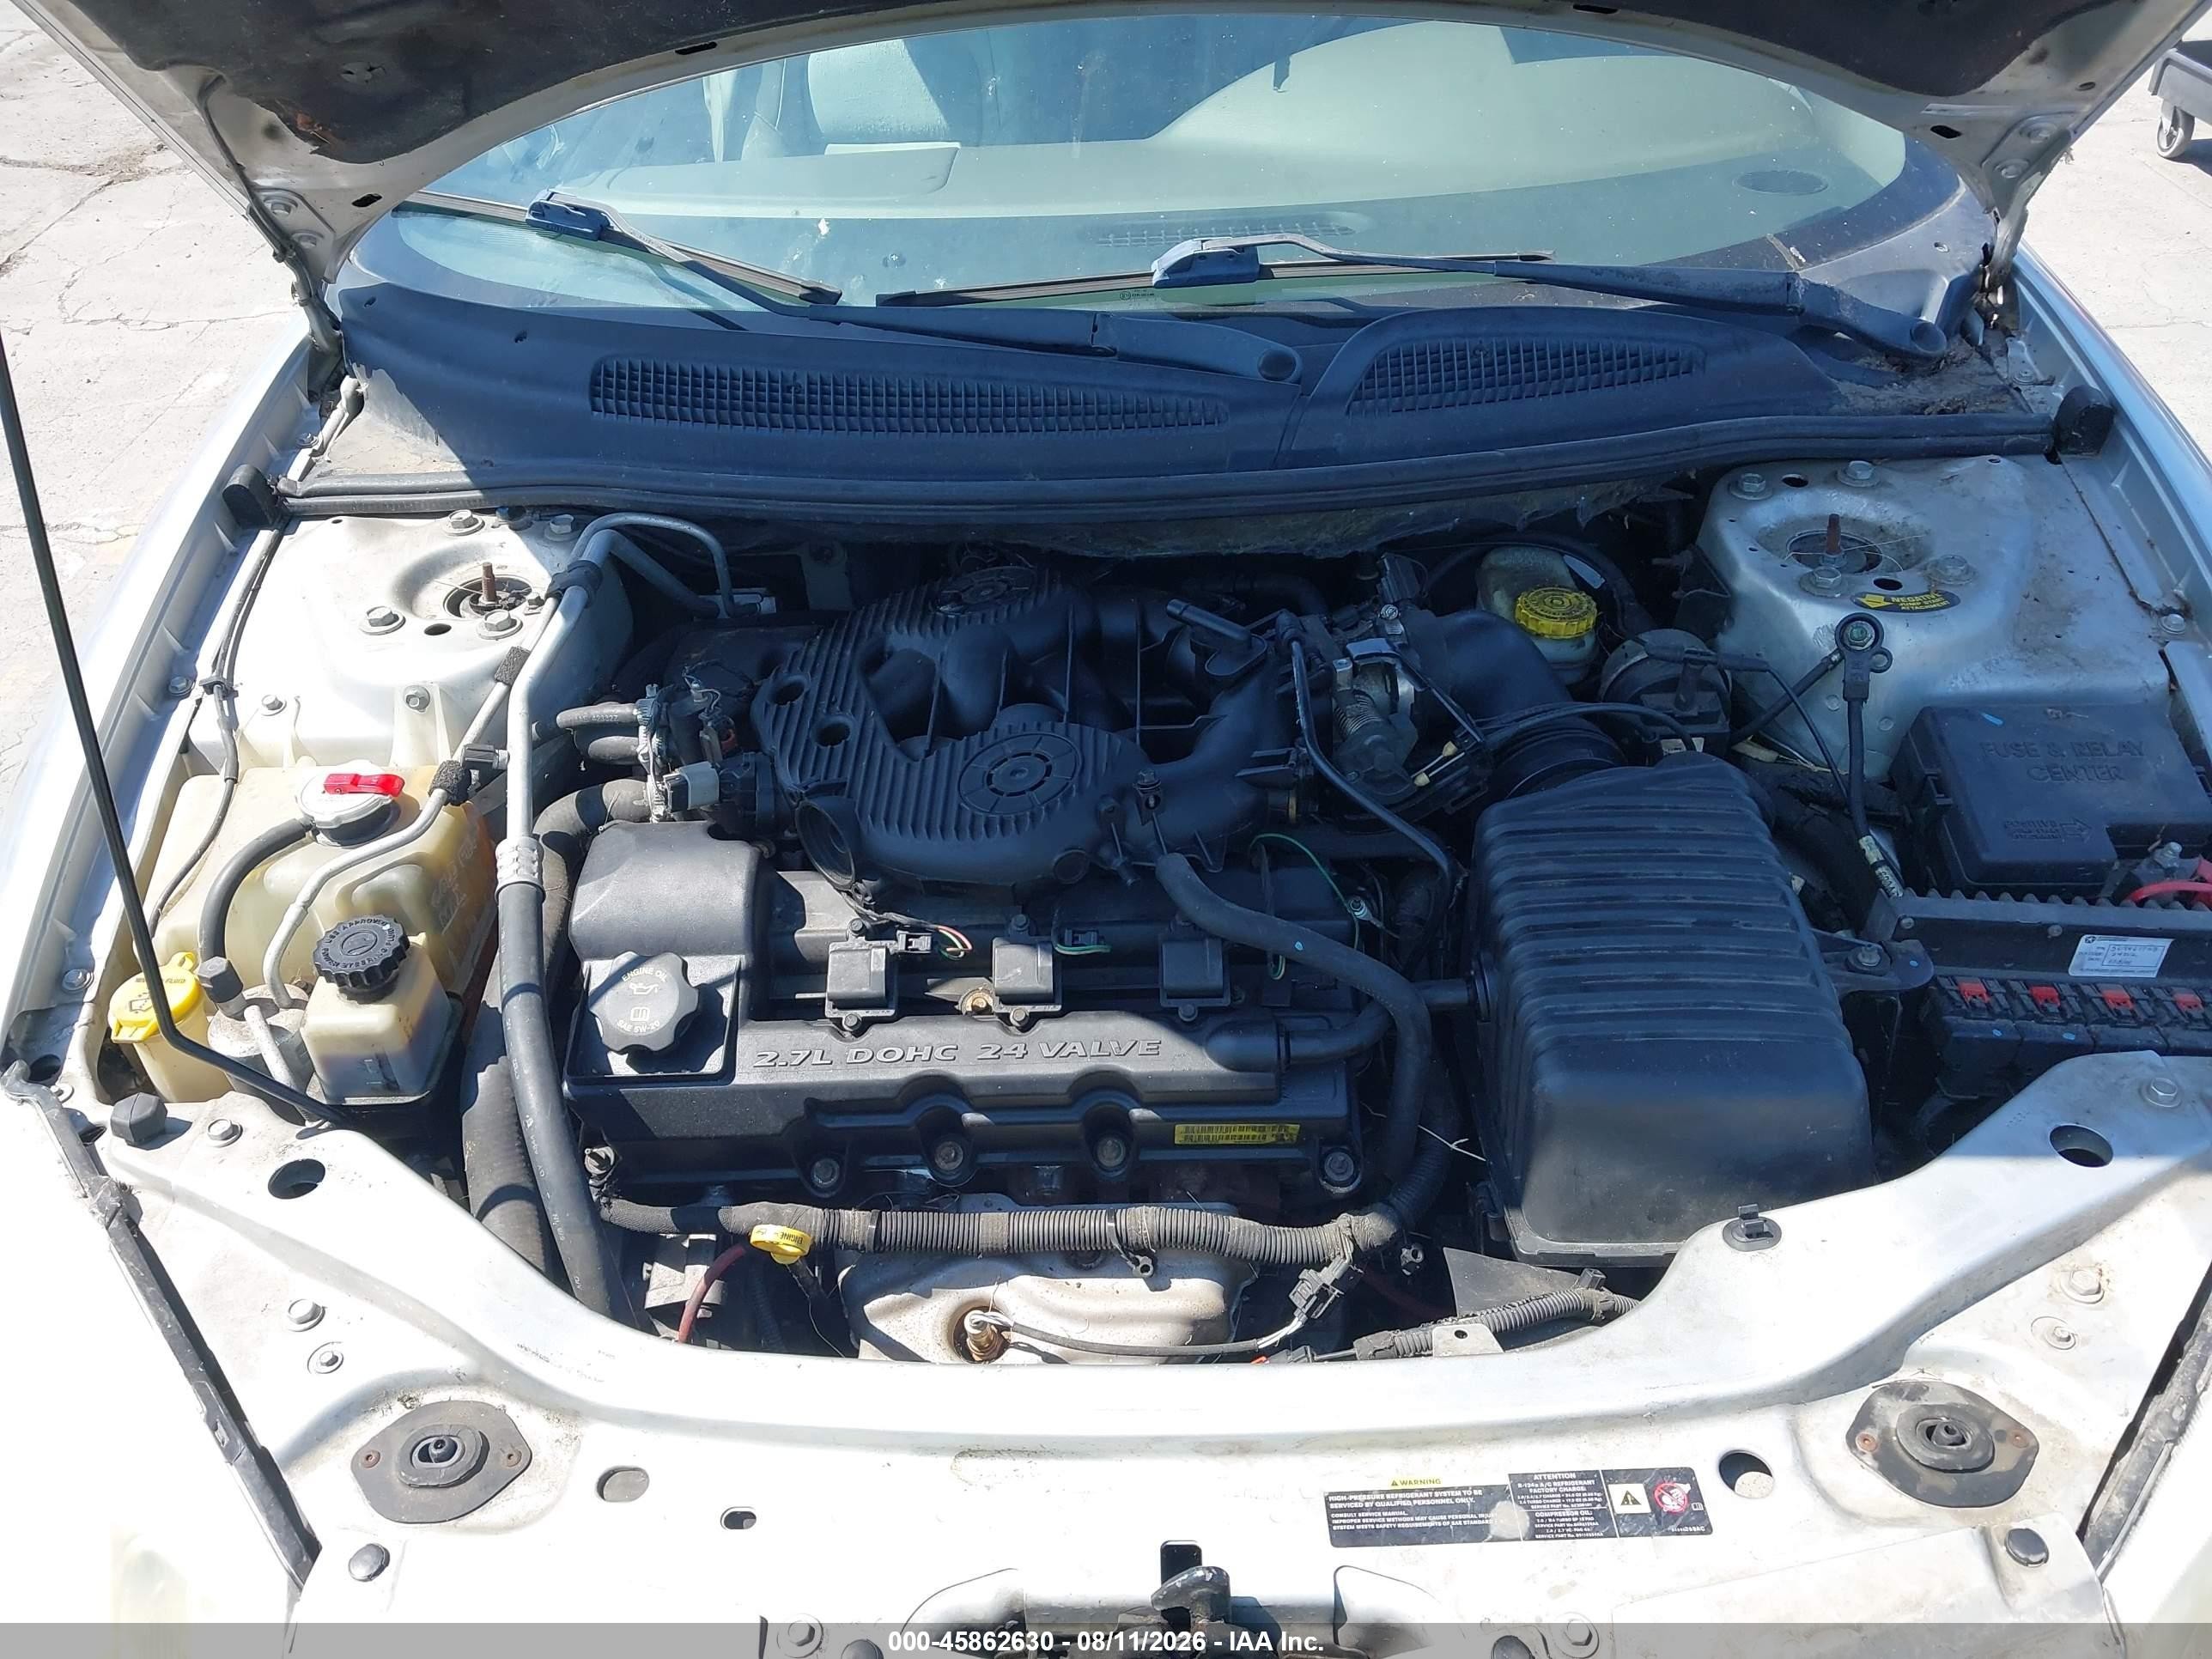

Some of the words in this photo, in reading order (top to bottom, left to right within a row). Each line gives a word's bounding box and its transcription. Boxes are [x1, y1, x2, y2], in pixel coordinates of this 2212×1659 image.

[1978, 741, 2040, 758] FUSE
[2047, 742, 2066, 757] &
[2070, 740, 2144, 757] RELAY
[2027, 764, 2125, 782] CENTER
[622, 967, 654, 982] ENGINE
[655, 969, 667, 982] OIL
[617, 1018, 633, 1032] SAE
[634, 1019, 660, 1033] 5W-20
[753, 1050, 833, 1068] 2.7L
[846, 1044, 959, 1065] DOHC
[976, 1043, 1029, 1060] 24
[1038, 1039, 1163, 1060] VALVE
[1534, 1472, 1577, 1480] ATTENTION
[1386, 1492, 1434, 1500] REFRIGERANT
[1413, 1498, 1455, 1506] PERSONNEL
